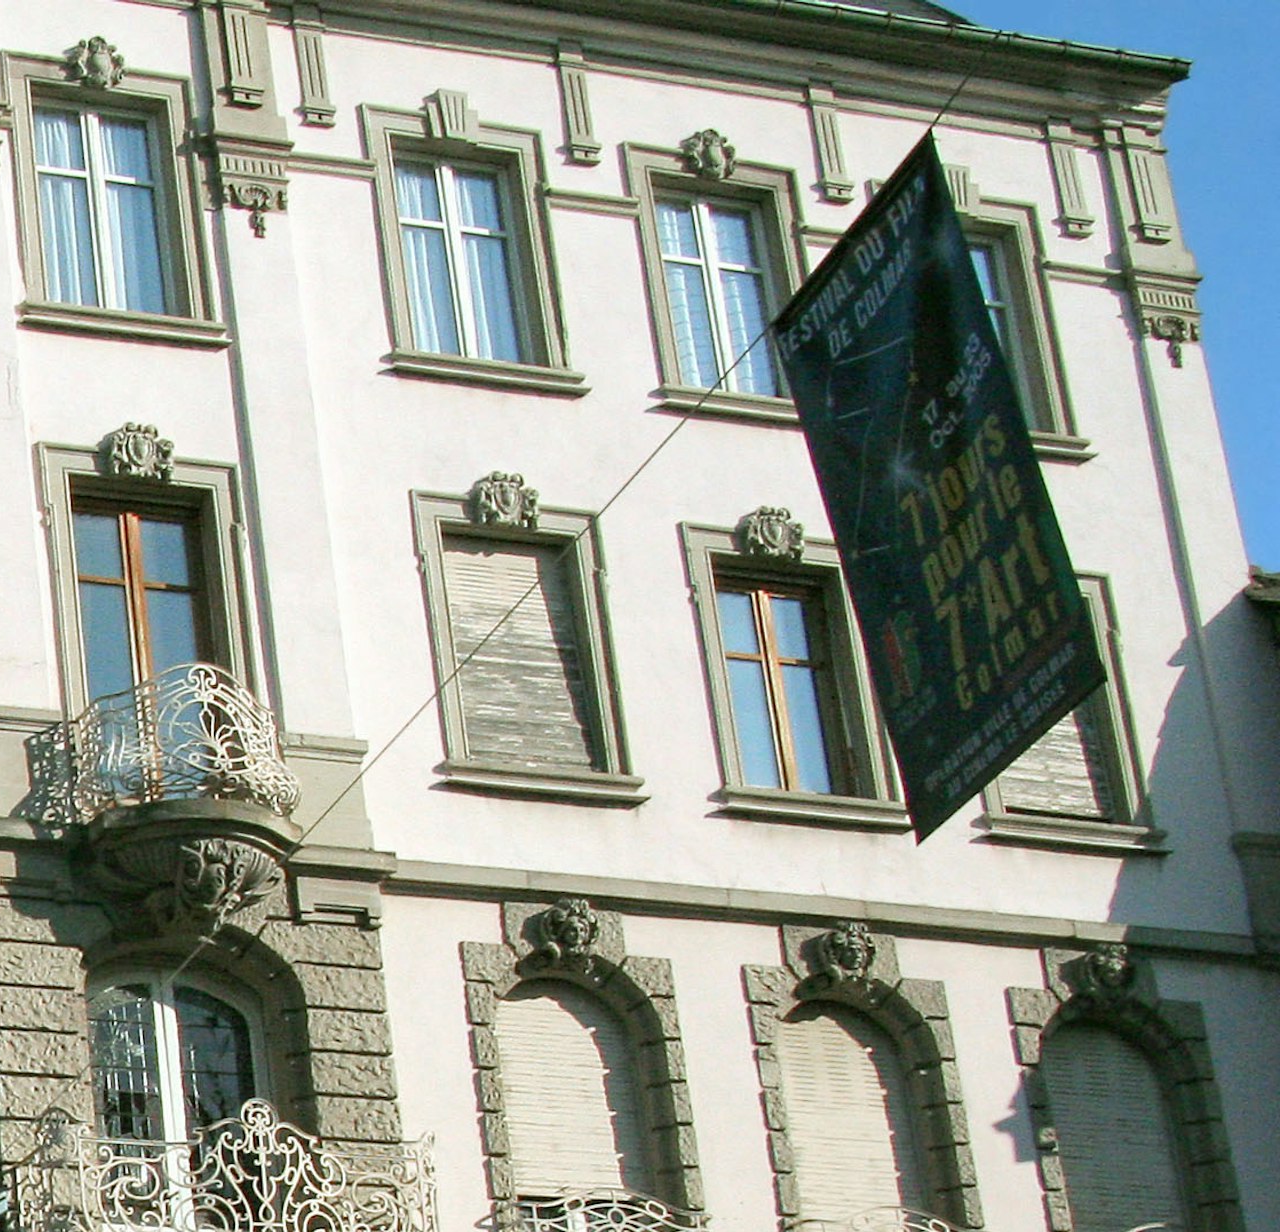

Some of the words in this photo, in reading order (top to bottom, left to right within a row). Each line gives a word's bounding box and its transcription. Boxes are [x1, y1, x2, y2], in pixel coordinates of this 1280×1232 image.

[853, 229, 885, 275] DU
[827, 317, 853, 358] DE
[901, 490, 925, 547] 7
[922, 500, 988, 606] pour
